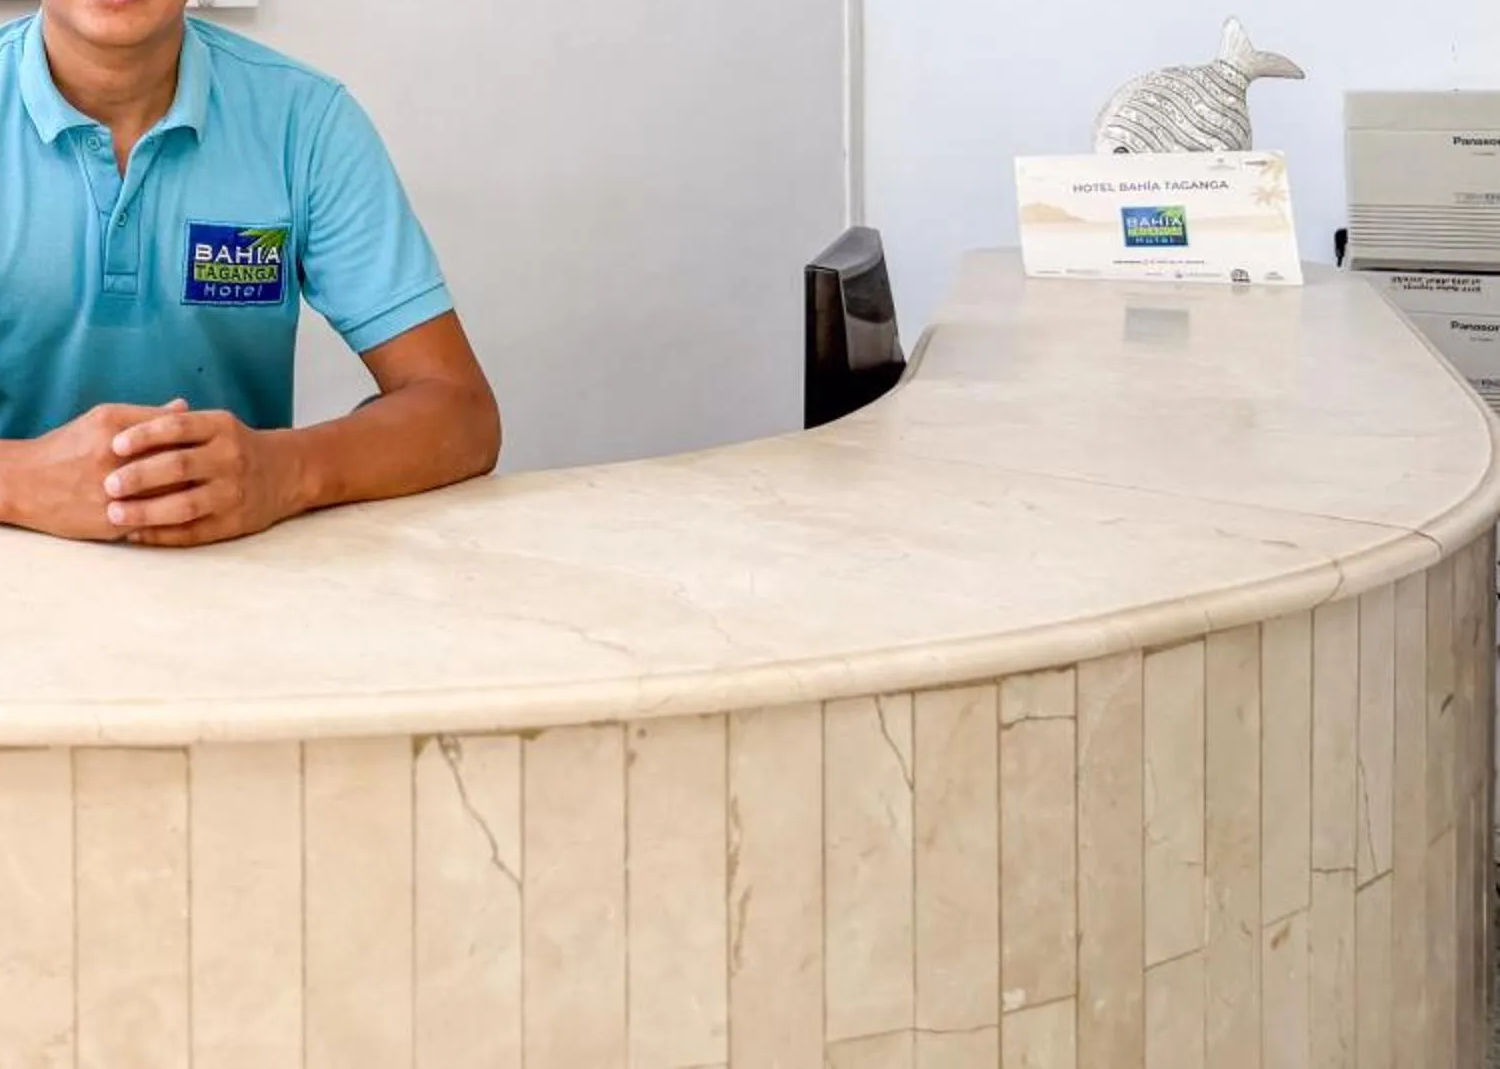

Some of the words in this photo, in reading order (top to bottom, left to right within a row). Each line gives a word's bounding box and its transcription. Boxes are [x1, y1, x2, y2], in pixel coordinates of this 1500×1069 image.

[1072, 182, 1115, 194] HOTEL
[1165, 180, 1229, 191] TAGANGA
[195, 264, 277, 281] TAGANGA
[204, 283, 263, 298] Hotel
